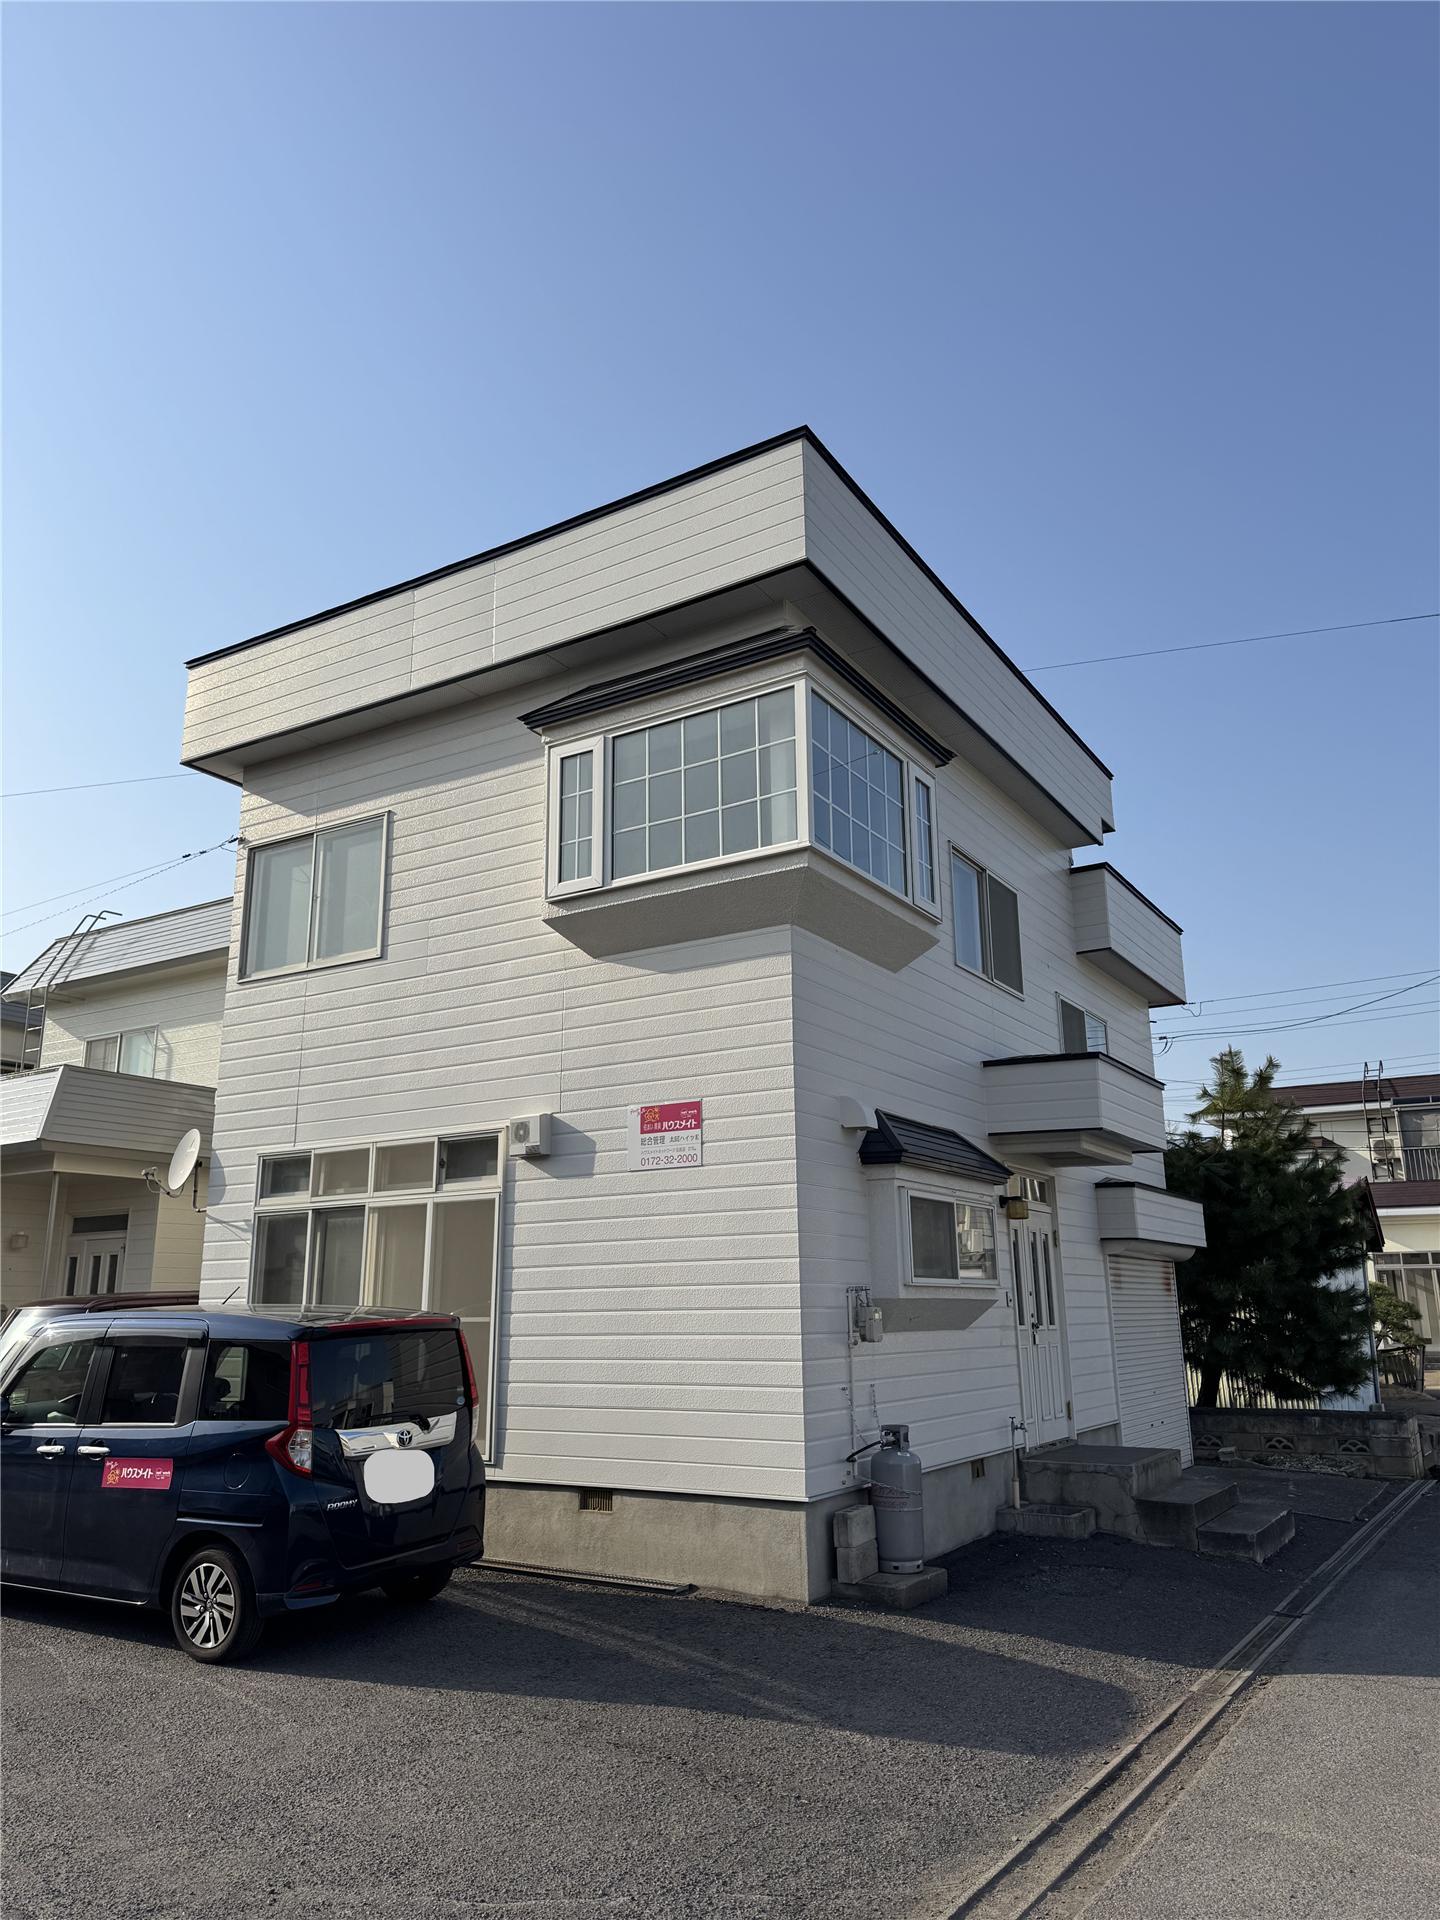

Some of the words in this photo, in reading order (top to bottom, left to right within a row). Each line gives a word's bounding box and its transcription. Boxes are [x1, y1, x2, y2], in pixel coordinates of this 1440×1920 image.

[662, 1119, 698, 1130] ハウスメイト
[641, 1136, 665, 1146] 総合管理
[641, 1153, 698, 1166] 0172-32-2000
[121, 1467, 153, 1478] ハウスメイト
